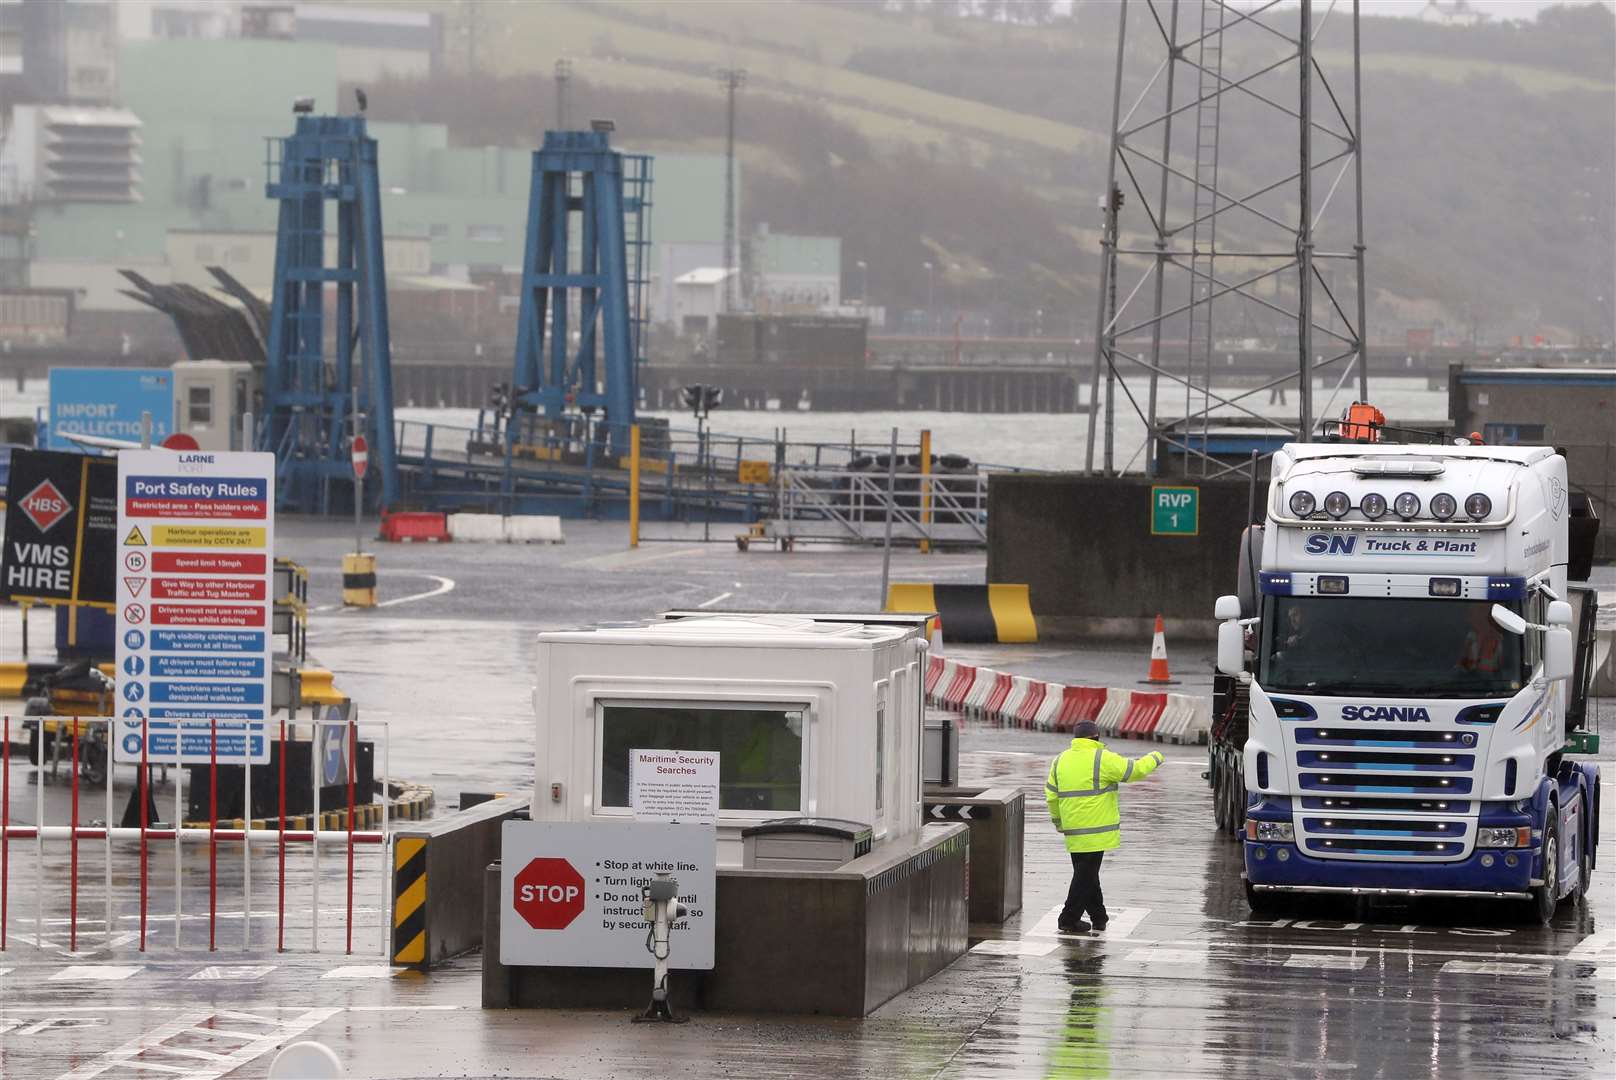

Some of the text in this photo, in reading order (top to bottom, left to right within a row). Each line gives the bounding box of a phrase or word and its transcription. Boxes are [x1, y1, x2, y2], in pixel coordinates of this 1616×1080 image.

[57, 403, 117, 417] IMPORT
[157, 422, 166, 435] 1
[178, 455, 214, 464] LARNE
[135, 482, 258, 498] Port Safety Rules
[28, 497, 62, 512] HBS
[1159, 493, 1192, 507] RVP
[132, 501, 170, 510] Restricted
[194, 502, 212, 511] Pass
[213, 503, 241, 511] holders
[242, 504, 260, 513] only.
[1170, 513, 1177, 528] 1
[198, 529, 237, 537] operations
[165, 537, 202, 545] monitored
[203, 538, 213, 546] by
[1306, 533, 1478, 555] SN Truck & Plant
[14, 542, 69, 567] VMS
[129, 557, 141, 567] 15
[175, 558, 242, 568] Speed limit 15mph
[7, 565, 71, 591] HIRE
[161, 580, 178, 588] Give
[179, 581, 195, 589] Way
[205, 581, 224, 589] other
[166, 589, 190, 597] Traffic
[206, 590, 219, 599] Tug
[221, 590, 250, 598] Masters
[158, 606, 184, 614] Drivers
[233, 608, 257, 616] mobile
[169, 616, 246, 625] phones whilst driving
[159, 632, 176, 641] High
[177, 633, 206, 641] visibility
[207, 633, 237, 642] clothing
[172, 641, 181, 649] be
[222, 642, 242, 650] times
[169, 658, 194, 666] drivers
[216, 659, 237, 667] follow
[163, 667, 183, 676] signs
[217, 669, 251, 677] markings
[168, 693, 245, 702] designated walkways
[164, 710, 191, 718] Drivers
[1341, 705, 1431, 723] SCANIA
[188, 744, 208, 752] driving
[639, 755, 714, 766] Maritime Security
[656, 766, 697, 775] Searches
[604, 860, 699, 871] Stop at white line.
[604, 876, 627, 885] Turn
[520, 884, 579, 903] STOP
[603, 893, 618, 901] Do
[621, 893, 639, 902] not
[603, 906, 644, 916] instruct
[603, 919, 690, 930] by securi taff.
